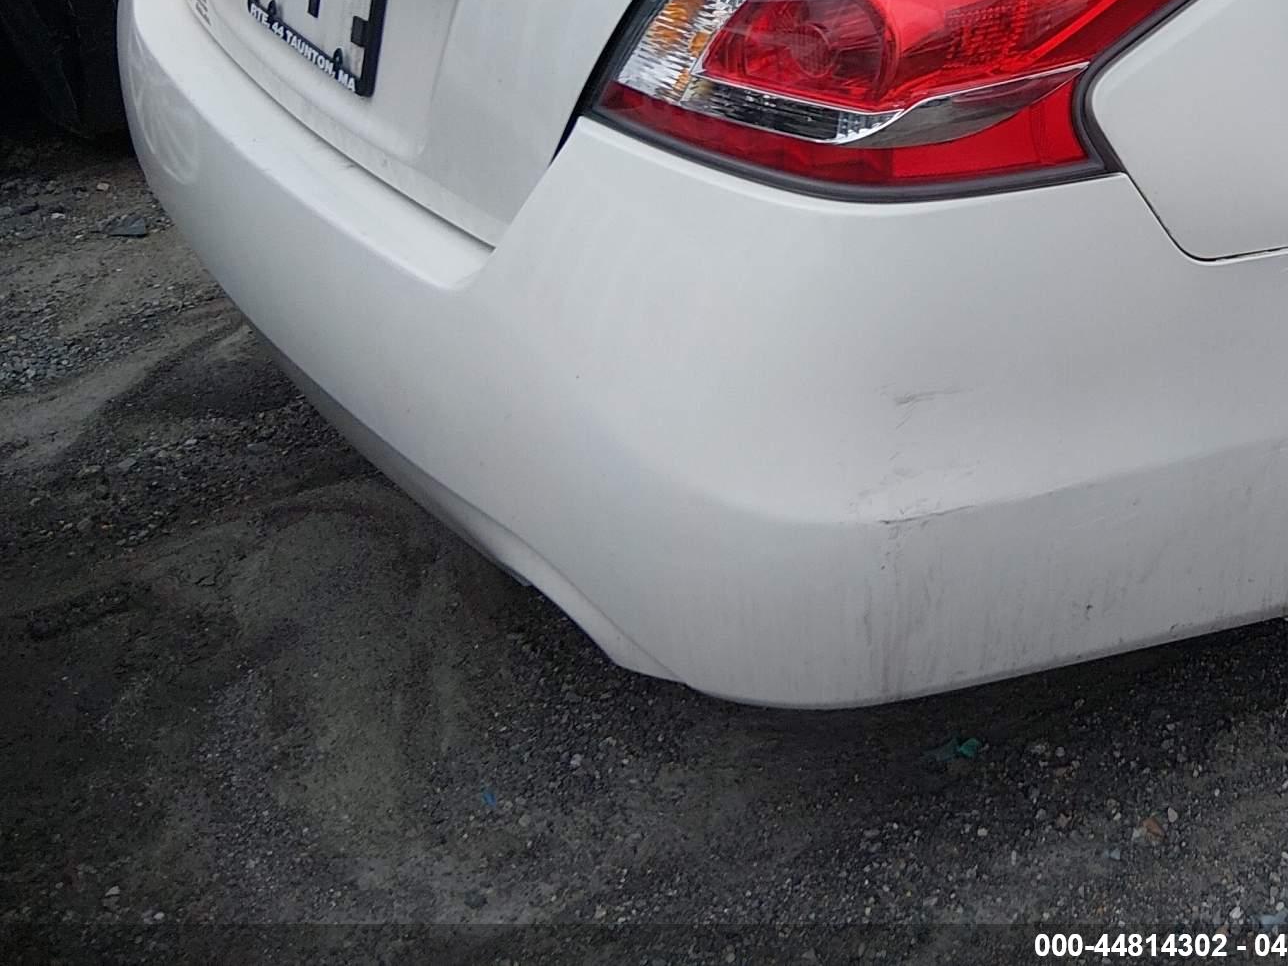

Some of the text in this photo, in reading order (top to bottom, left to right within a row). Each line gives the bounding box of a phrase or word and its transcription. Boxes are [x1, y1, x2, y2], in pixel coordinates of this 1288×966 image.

[271, 22, 284, 38] 44
[286, 30, 336, 80] TAUNTON,
[338, 69, 356, 92] MA
